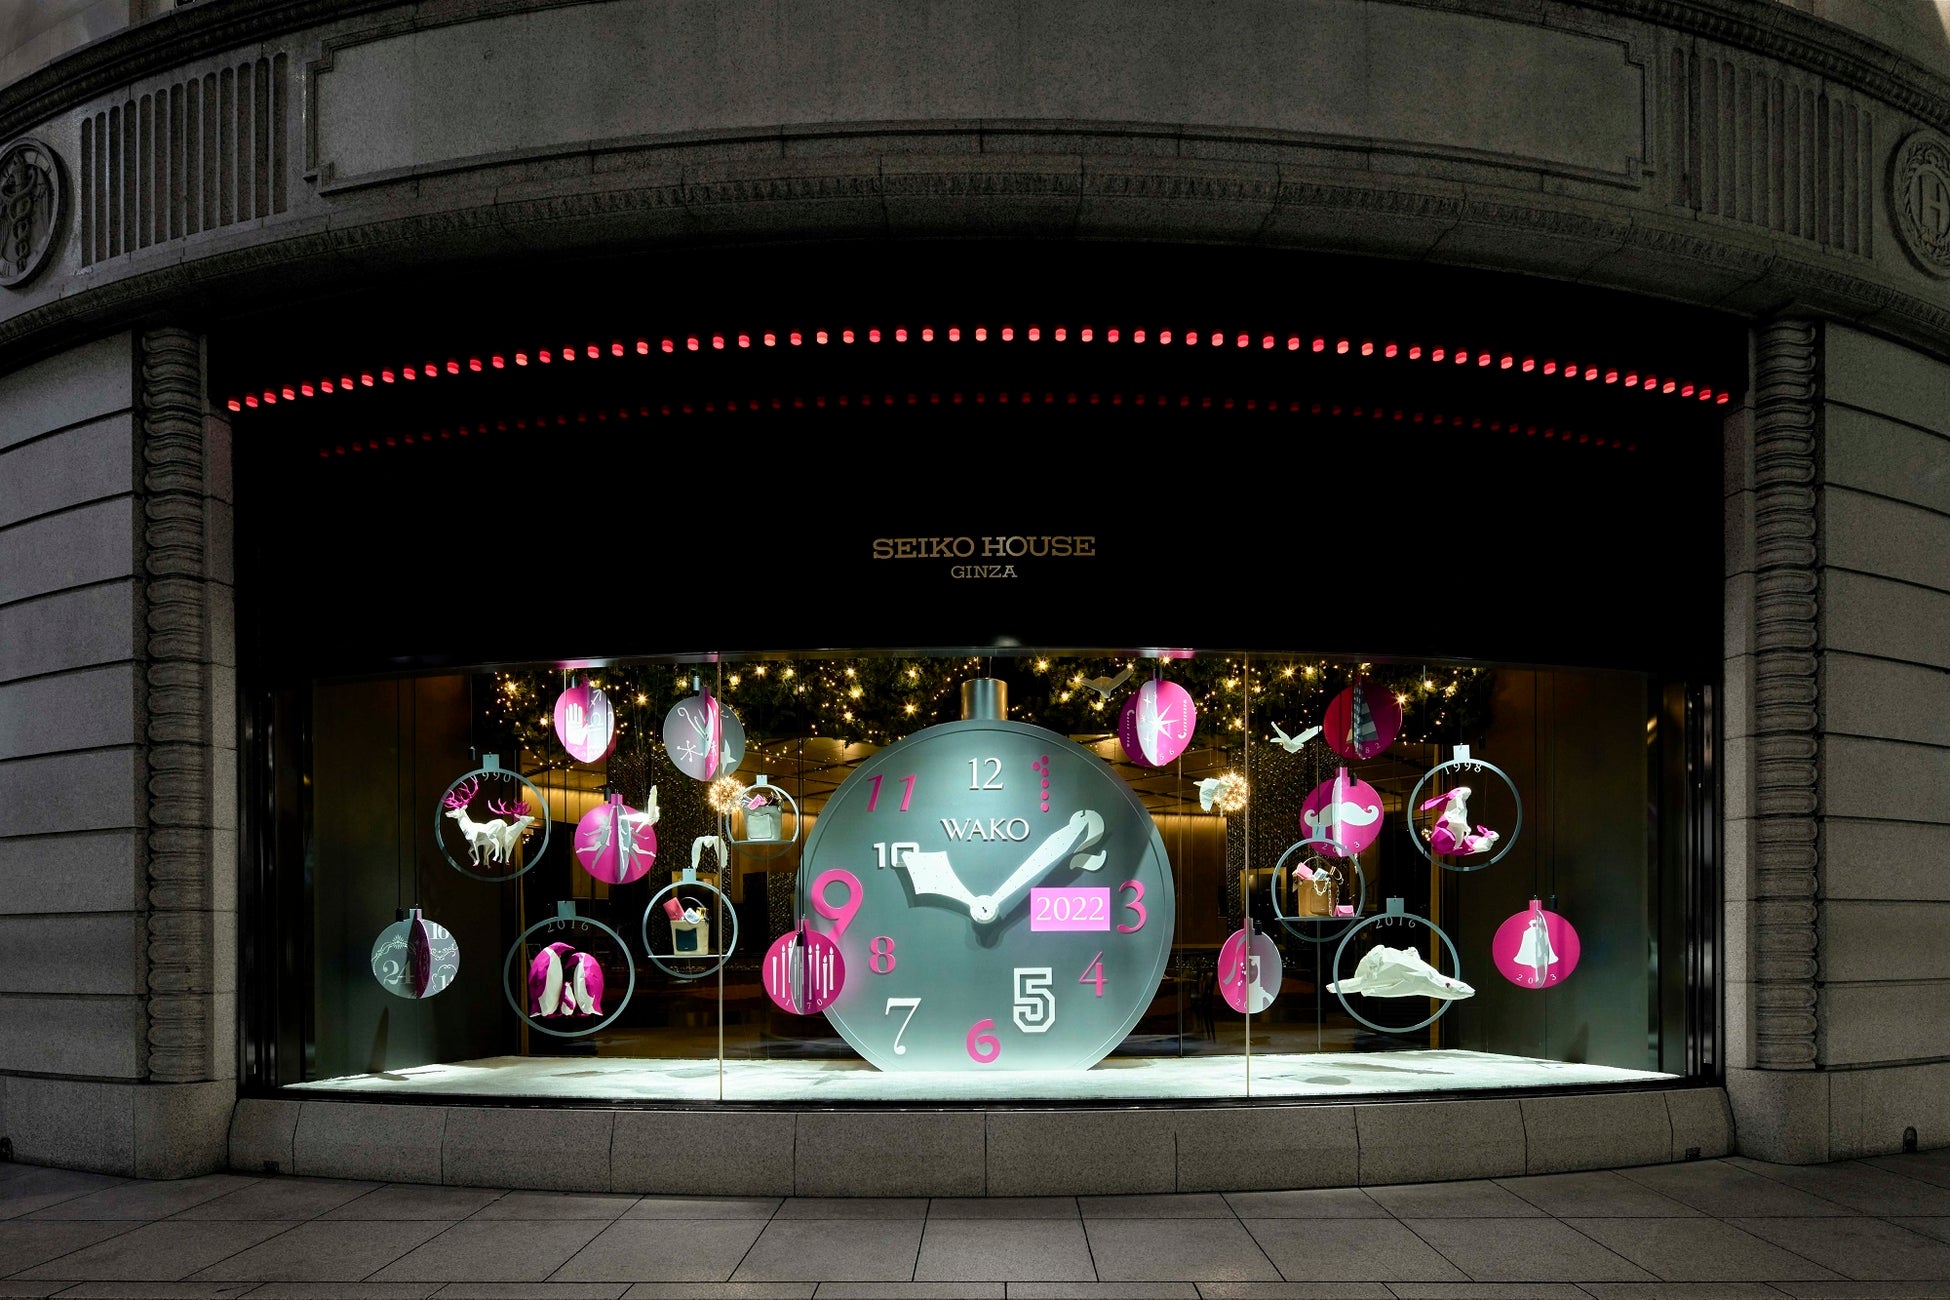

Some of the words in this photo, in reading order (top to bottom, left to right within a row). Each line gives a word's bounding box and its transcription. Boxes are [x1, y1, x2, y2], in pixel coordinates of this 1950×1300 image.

[873, 536, 975, 559] SEIKO
[981, 536, 1096, 557] HOUSE
[950, 565, 1018, 579] GINZA
[968, 757, 1004, 790] 12
[940, 817, 1030, 842] WAKO
[810, 868, 865, 944] 9
[1035, 896, 1106, 922] 2022
[1116, 879, 1148, 934] 3
[868, 936, 897, 975] 8
[1078, 951, 1109, 998] 4
[1012, 966, 1057, 1034] 5
[884, 996, 922, 1056] 7
[965, 1017, 1002, 1064] 6
